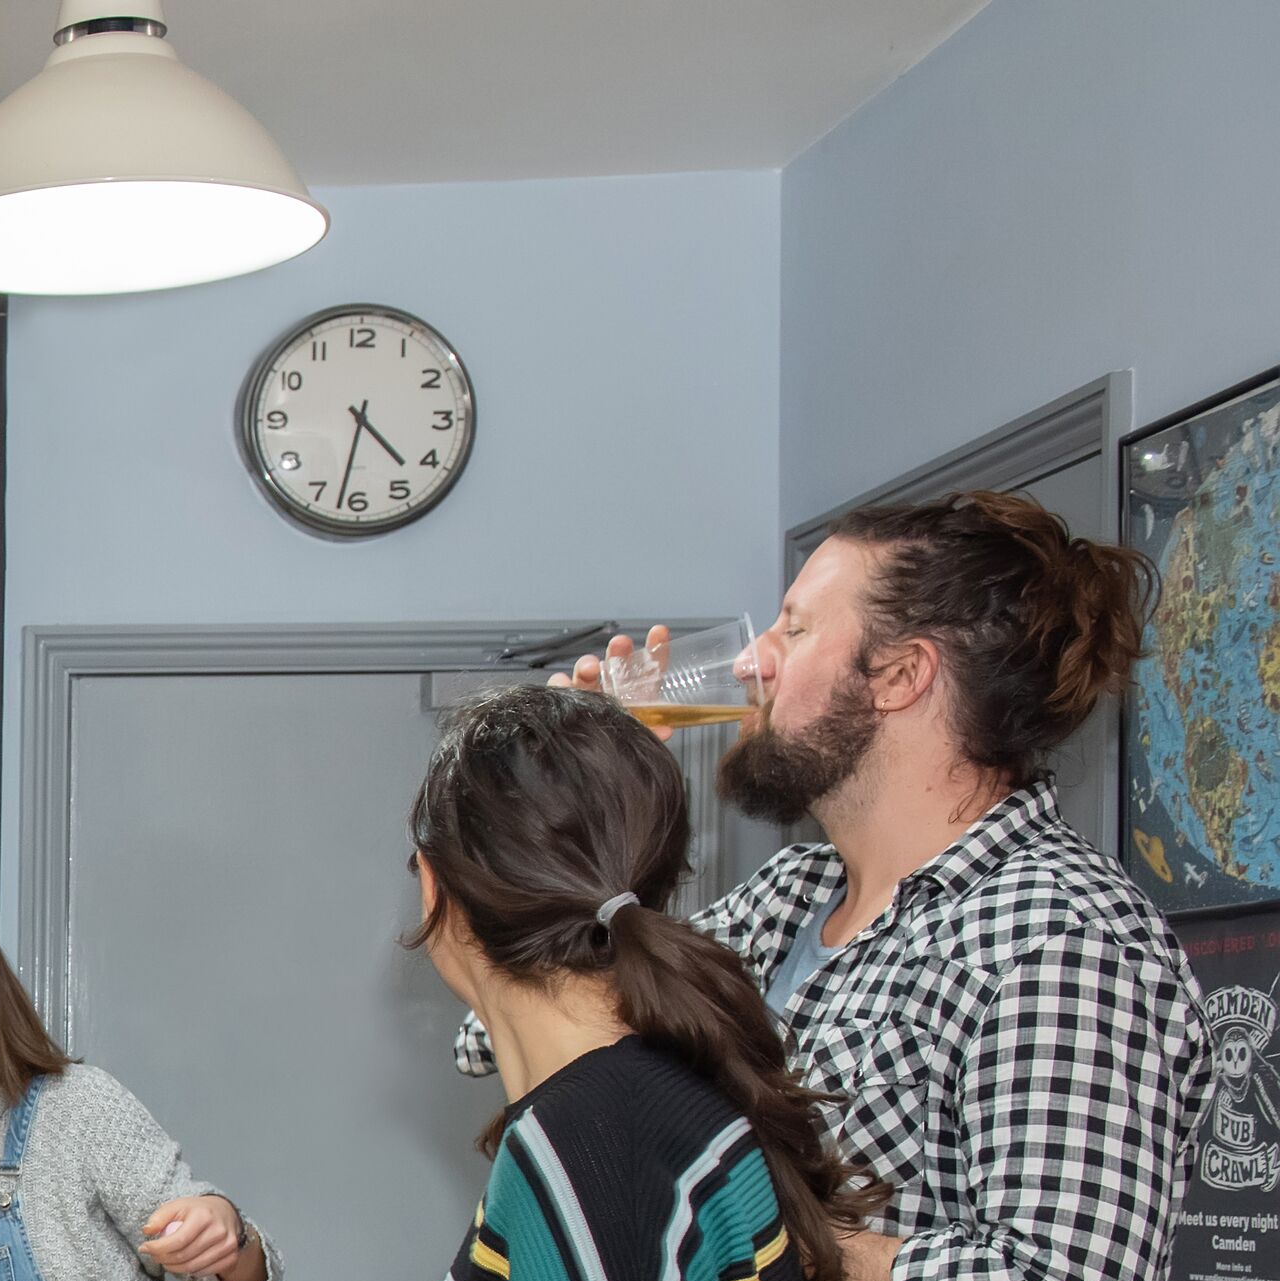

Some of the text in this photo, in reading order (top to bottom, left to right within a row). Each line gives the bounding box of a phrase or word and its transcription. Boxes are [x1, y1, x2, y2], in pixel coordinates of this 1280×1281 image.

[349, 328, 376, 348] 12
[401, 338, 406, 358] 1
[312, 341, 326, 361] 11
[281, 371, 302, 391] 10
[420, 369, 441, 388] 2
[266, 411, 288, 429] 9
[432, 410, 454, 430] 3
[280, 451, 302, 470] 8
[419, 449, 440, 469] 4
[308, 481, 327, 502] 7
[389, 480, 411, 500] 5
[347, 492, 369, 512] 6
[1207, 991, 1272, 1029] CAMDEN
[1221, 1113, 1250, 1142] PUB
[1208, 1149, 1266, 1183] CRAWL
[1179, 1211, 1279, 1233] Meet us every night
[1212, 1235, 1256, 1251] Camden
[1216, 1262, 1230, 1271] More
